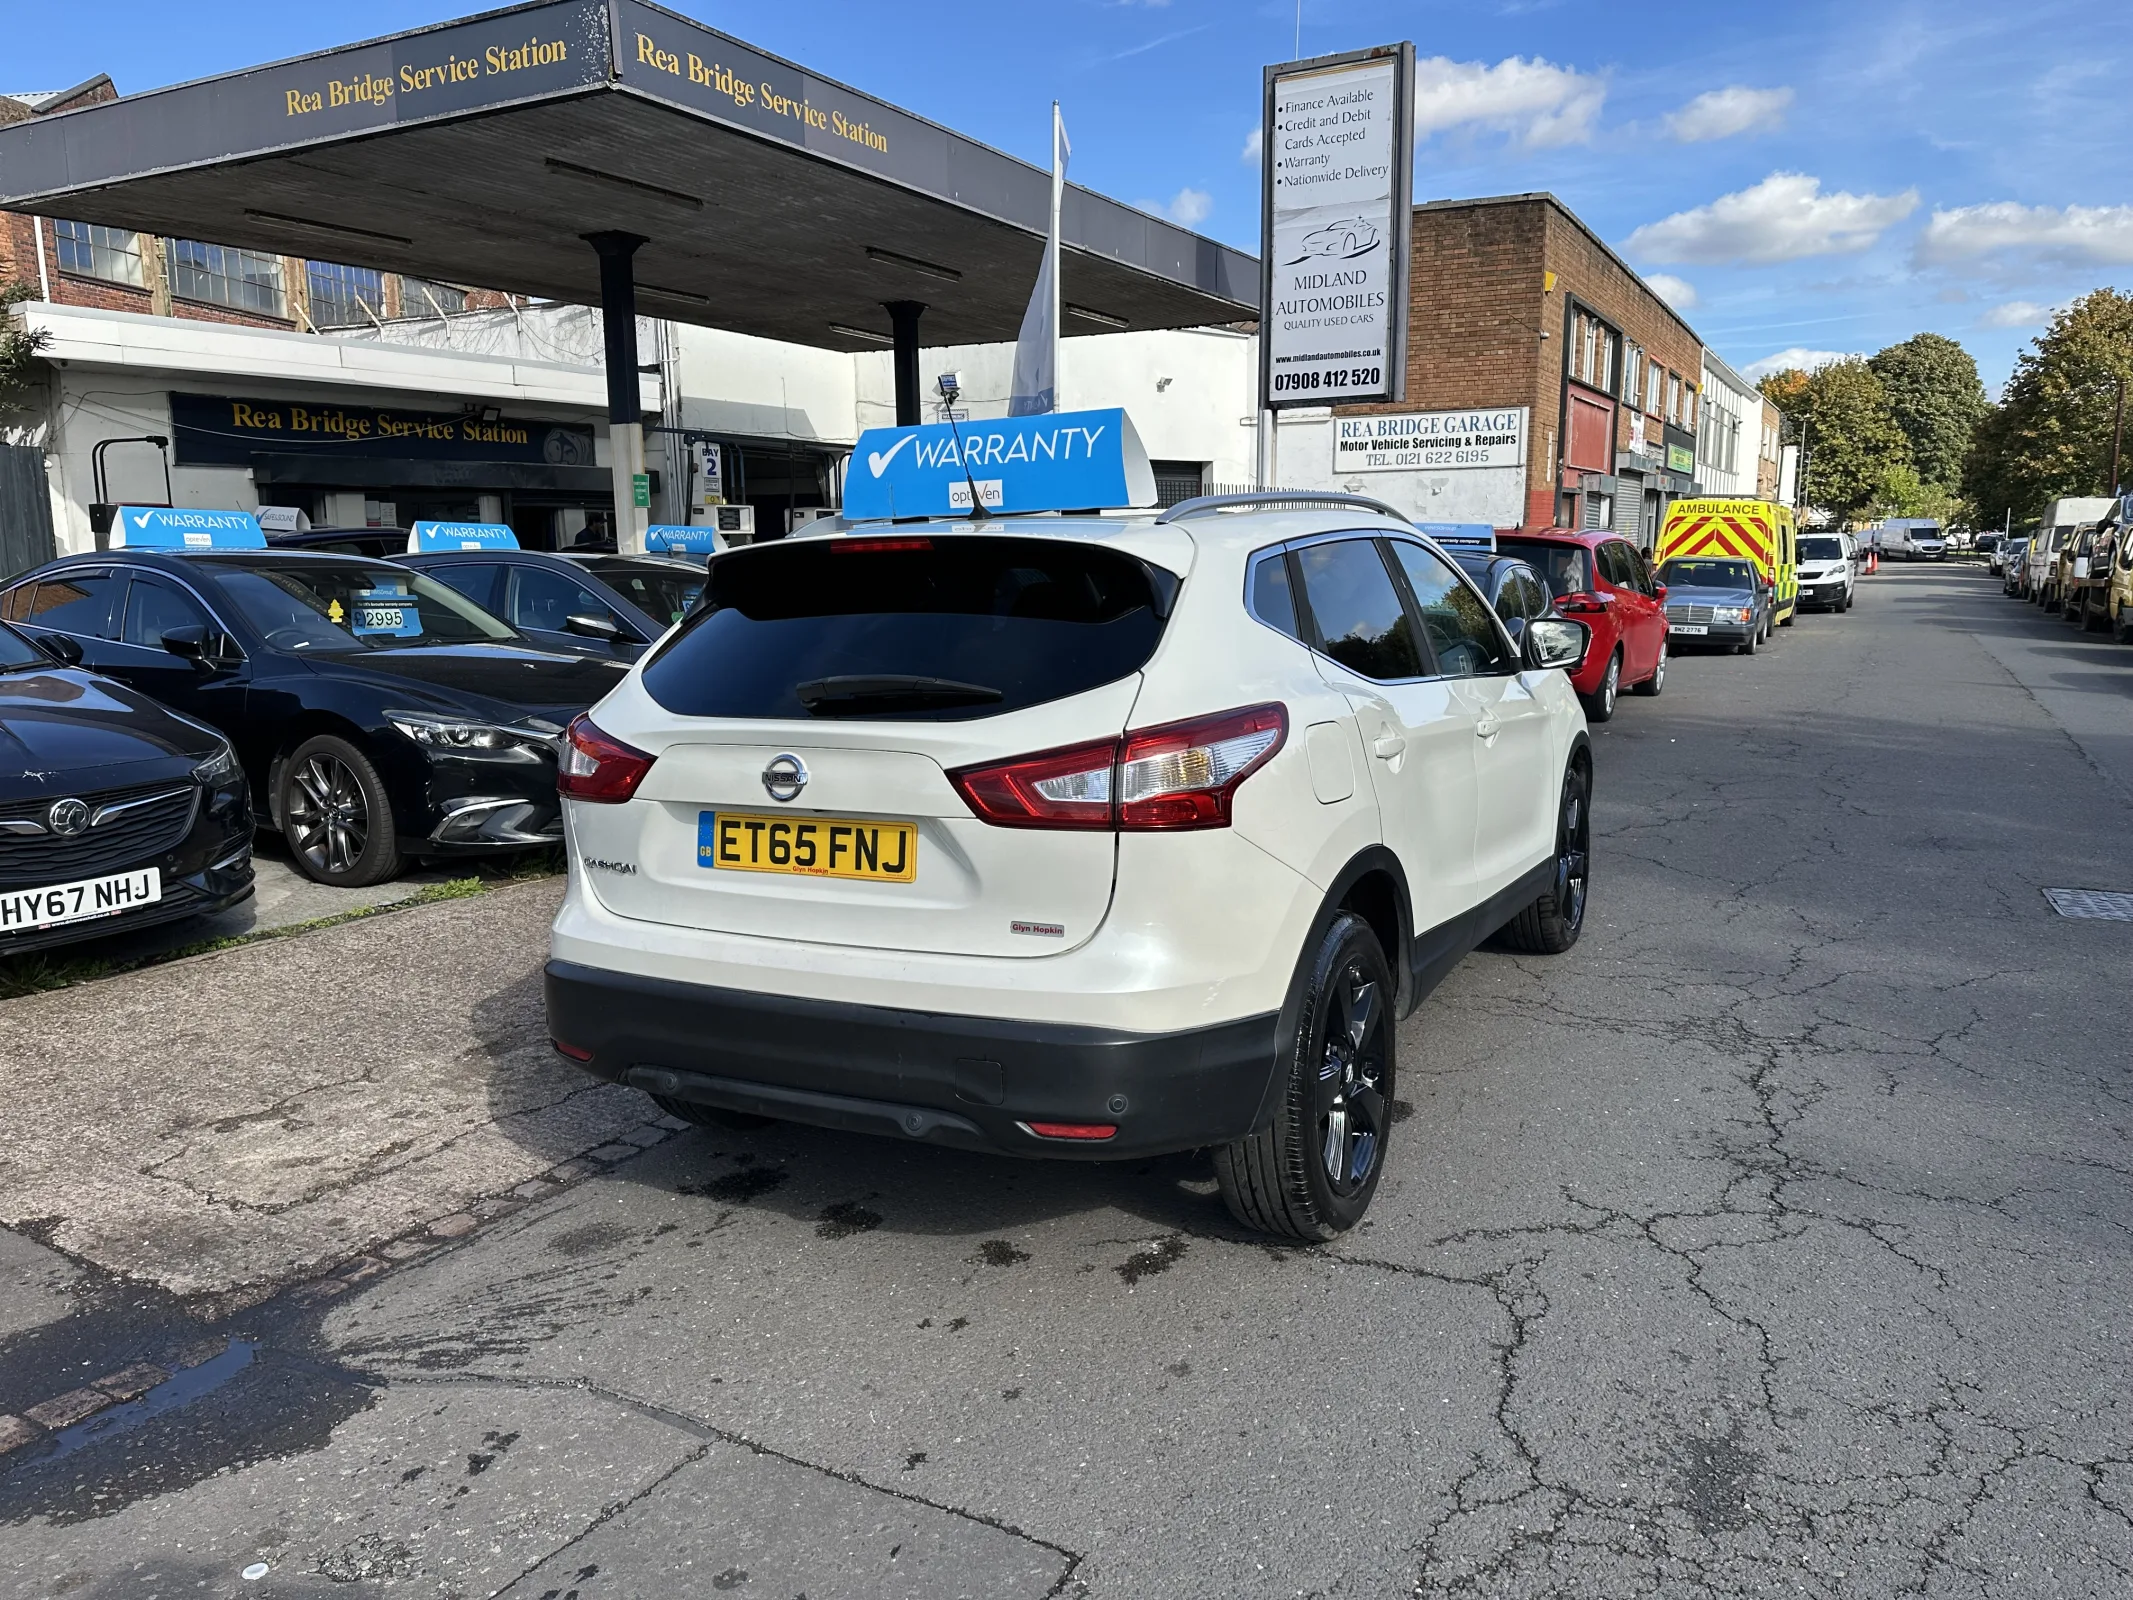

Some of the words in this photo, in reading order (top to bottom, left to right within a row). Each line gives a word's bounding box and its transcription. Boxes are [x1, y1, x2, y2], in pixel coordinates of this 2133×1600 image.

[285, 89, 322, 116] Rea
[328, 74, 394, 106] Bridge
[399, 55, 479, 93] Service
[485, 36, 567, 75] Station
[634, 32, 680, 75] Rea
[686, 52, 755, 107] Bridge
[760, 82, 827, 130] Service
[832, 110, 888, 153] Station
[1285, 99, 1324, 114] Finance
[1327, 89, 1374, 107] Available
[1285, 117, 1316, 132] Credit
[1320, 113, 1338, 127] and
[1342, 109, 1371, 124] Debit
[1285, 136, 1314, 150] Cards
[1316, 127, 1366, 147] Accepted
[1284, 153, 1331, 169] Warranty
[1284, 169, 1342, 187] Nationwide
[1345, 164, 1389, 179] Delivery
[1294, 270, 1367, 291] MIDLAND
[1276, 291, 1385, 315] AUTOMOBILES
[1284, 319, 1322, 331] QUALITY
[1324, 316, 1348, 327] USED
[1350, 313, 1374, 324] CARS
[1275, 348, 1381, 364] www.midlandautomobiles.co.uk
[1275, 371, 1320, 391] 07908
[1323, 369, 1348, 387] 412
[1351, 367, 1380, 386] 520
[232, 402, 282, 430] Rea
[290, 407, 371, 439] Bridge
[377, 413, 454, 440] Service
[463, 420, 528, 444] Station
[1341, 421, 1373, 438] REA
[1377, 417, 1440, 437] BRIDGE
[1444, 413, 1517, 433] GARAGE
[702, 448, 719, 457] BAY
[915, 425, 1106, 469] WARRANTY
[1340, 440, 1369, 452] Motor
[1371, 438, 1410, 450] Vehicle
[1412, 435, 1461, 450] Servicing
[1464, 436, 1472, 447] &
[1475, 434, 1516, 447] Repairs
[706, 458, 717, 476] 2
[1366, 453, 1392, 466] TEL.
[1396, 452, 1421, 465] 0121
[1425, 451, 1451, 464] 622
[1456, 450, 1489, 463] 6195
[952, 483, 1000, 505] optven
[1677, 504, 1760, 515] AMBULANCE
[156, 513, 249, 530] WARRANTY
[441, 526, 508, 540] WARRANTY
[662, 530, 710, 541] WARRANTY
[765, 773, 801, 783] NISSAN
[700, 846, 711, 857] GB
[720, 820, 817, 868] ET65
[828, 826, 907, 874] FNJ
[1, 887, 85, 925] HY67
[95, 874, 150, 909] NHJ
[1012, 923, 1031, 933] Glyn
[1033, 925, 1063, 934] Hopkin
